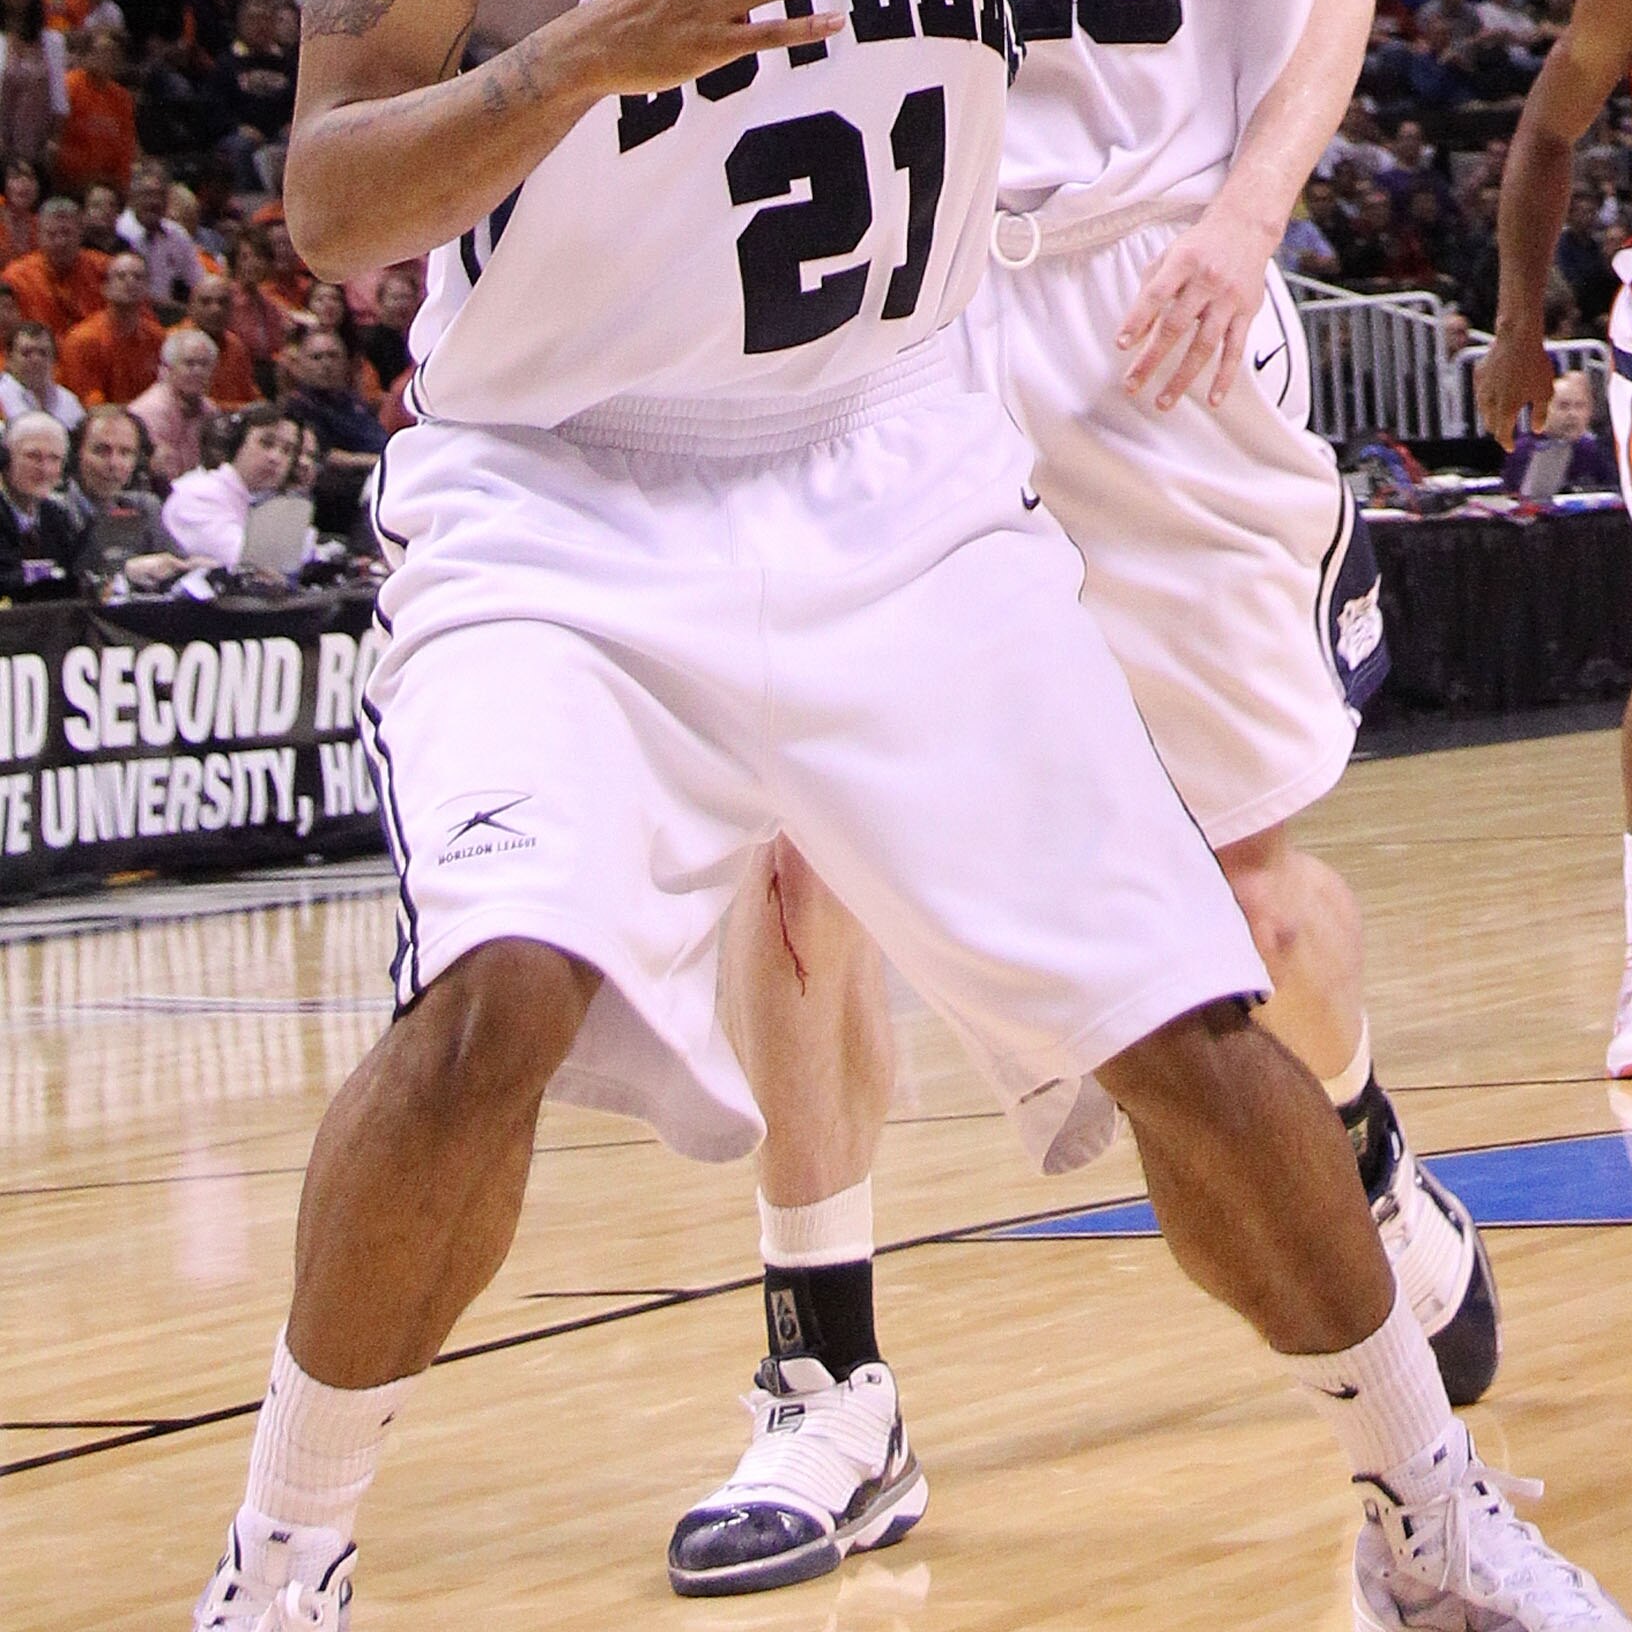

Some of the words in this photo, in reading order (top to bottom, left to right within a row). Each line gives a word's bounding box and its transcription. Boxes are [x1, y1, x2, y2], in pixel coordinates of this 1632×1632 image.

[724, 85, 946, 354] 21
[61, 636, 304, 753] SECOND
[437, 842, 493, 866] HORIZON
[496, 837, 536, 852] LEAGUE
